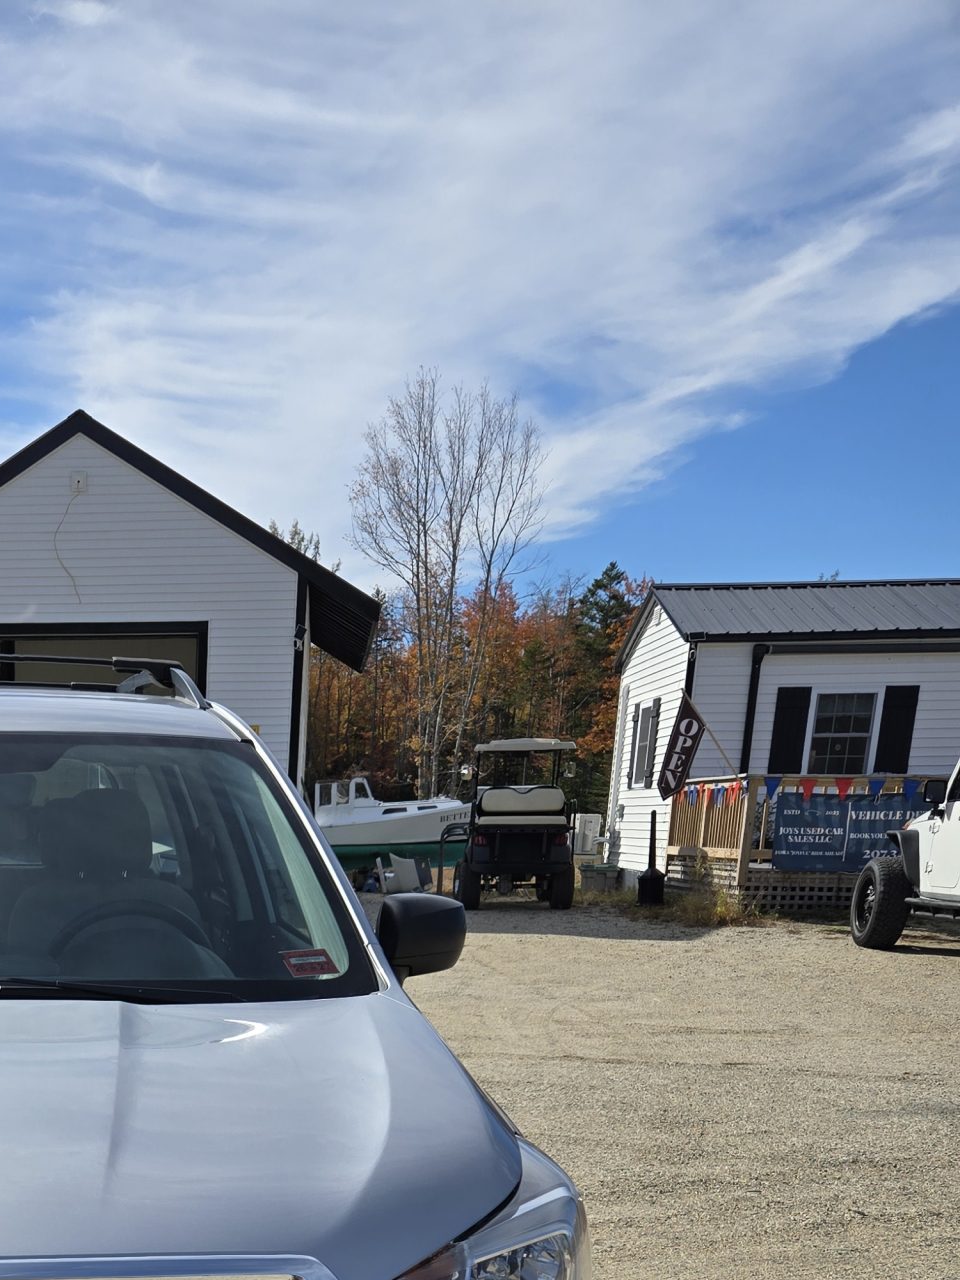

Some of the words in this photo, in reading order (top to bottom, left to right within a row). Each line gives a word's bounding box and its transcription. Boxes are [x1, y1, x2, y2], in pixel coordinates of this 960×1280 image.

[661, 718, 700, 790] OPEN
[851, 810, 903, 820] VEHICLE
[779, 826, 799, 836] JOYS
[800, 827, 825, 835] USED
[825, 827, 844, 836] CAR
[787, 835, 814, 844] SALES
[815, 835, 833, 843] LLC
